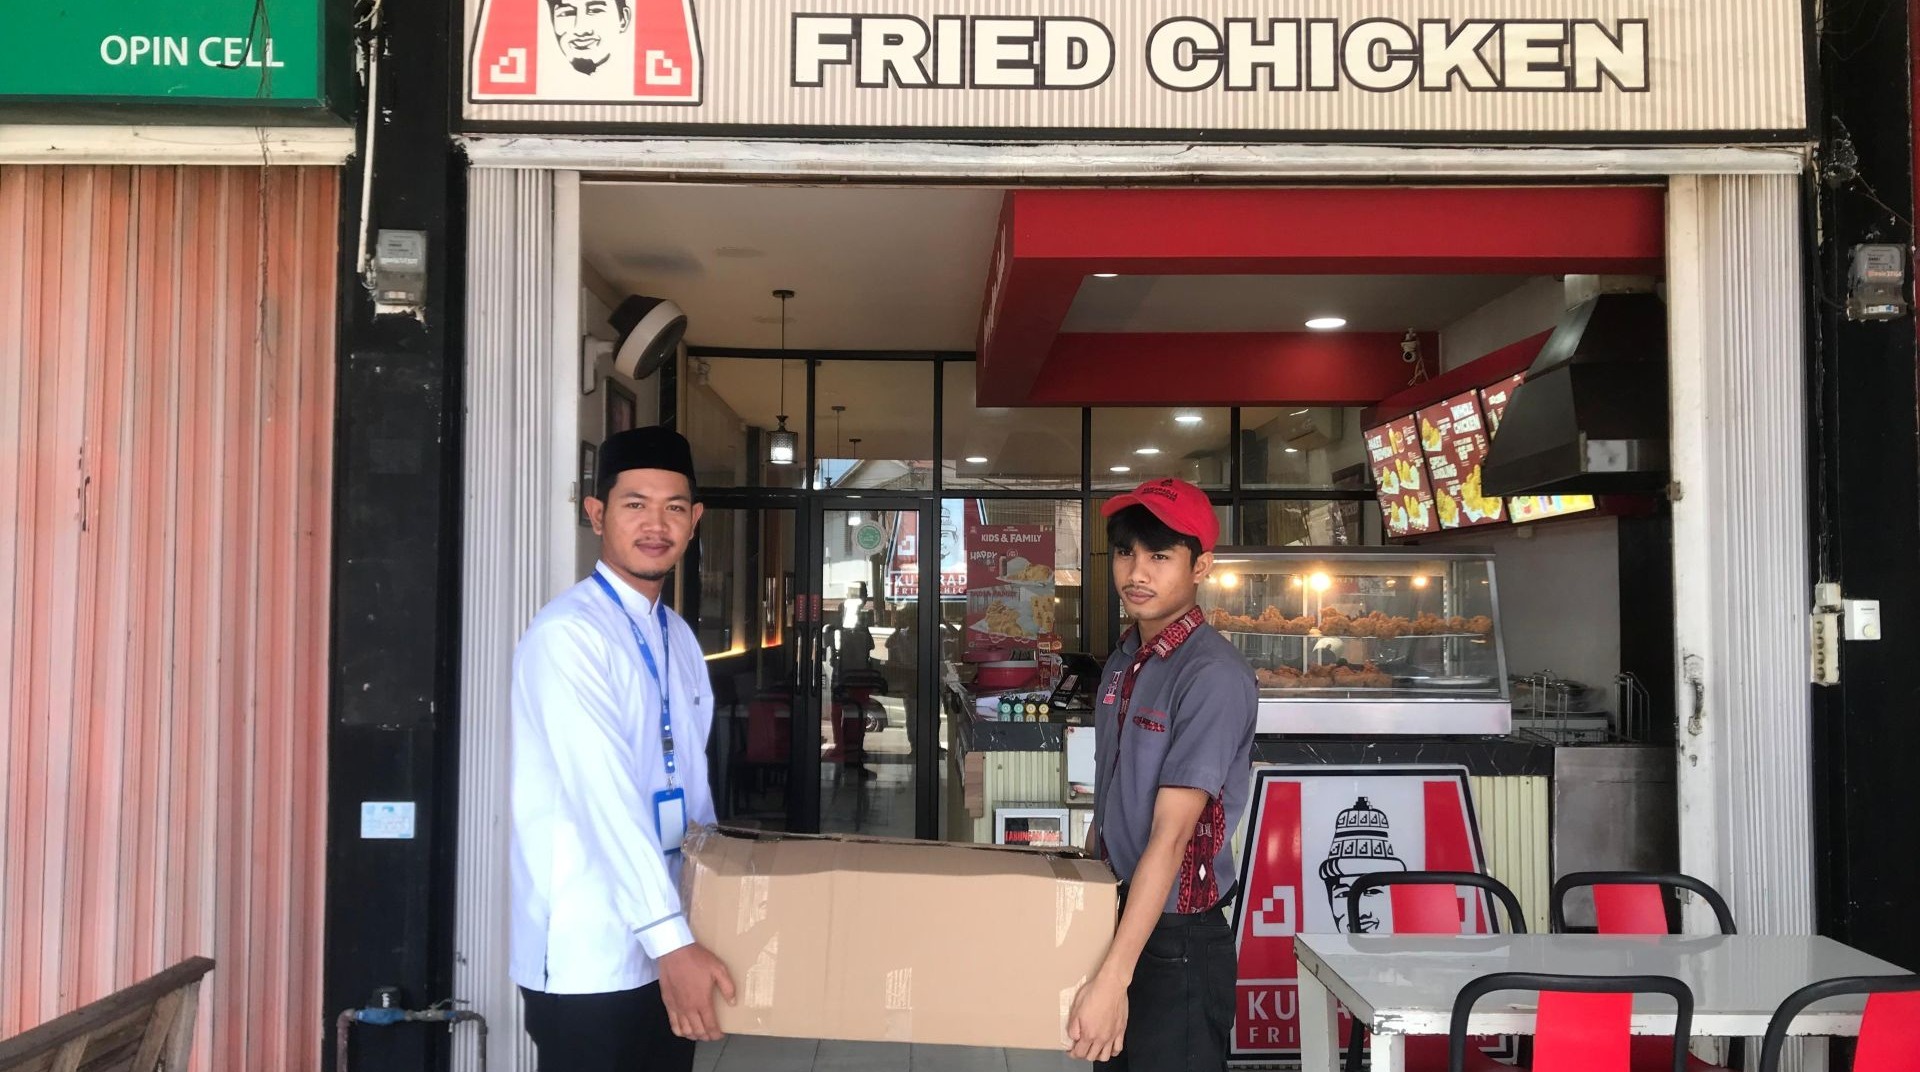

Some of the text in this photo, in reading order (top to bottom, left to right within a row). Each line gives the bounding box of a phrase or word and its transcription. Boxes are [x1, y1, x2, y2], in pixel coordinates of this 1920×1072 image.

[100, 35, 285, 68] OPIN CELL
[791, 12, 1650, 93] FRIED CHICKEN
[981, 533, 1042, 543] KIDS & FAMILY
[970, 550, 998, 561] HAPPY
